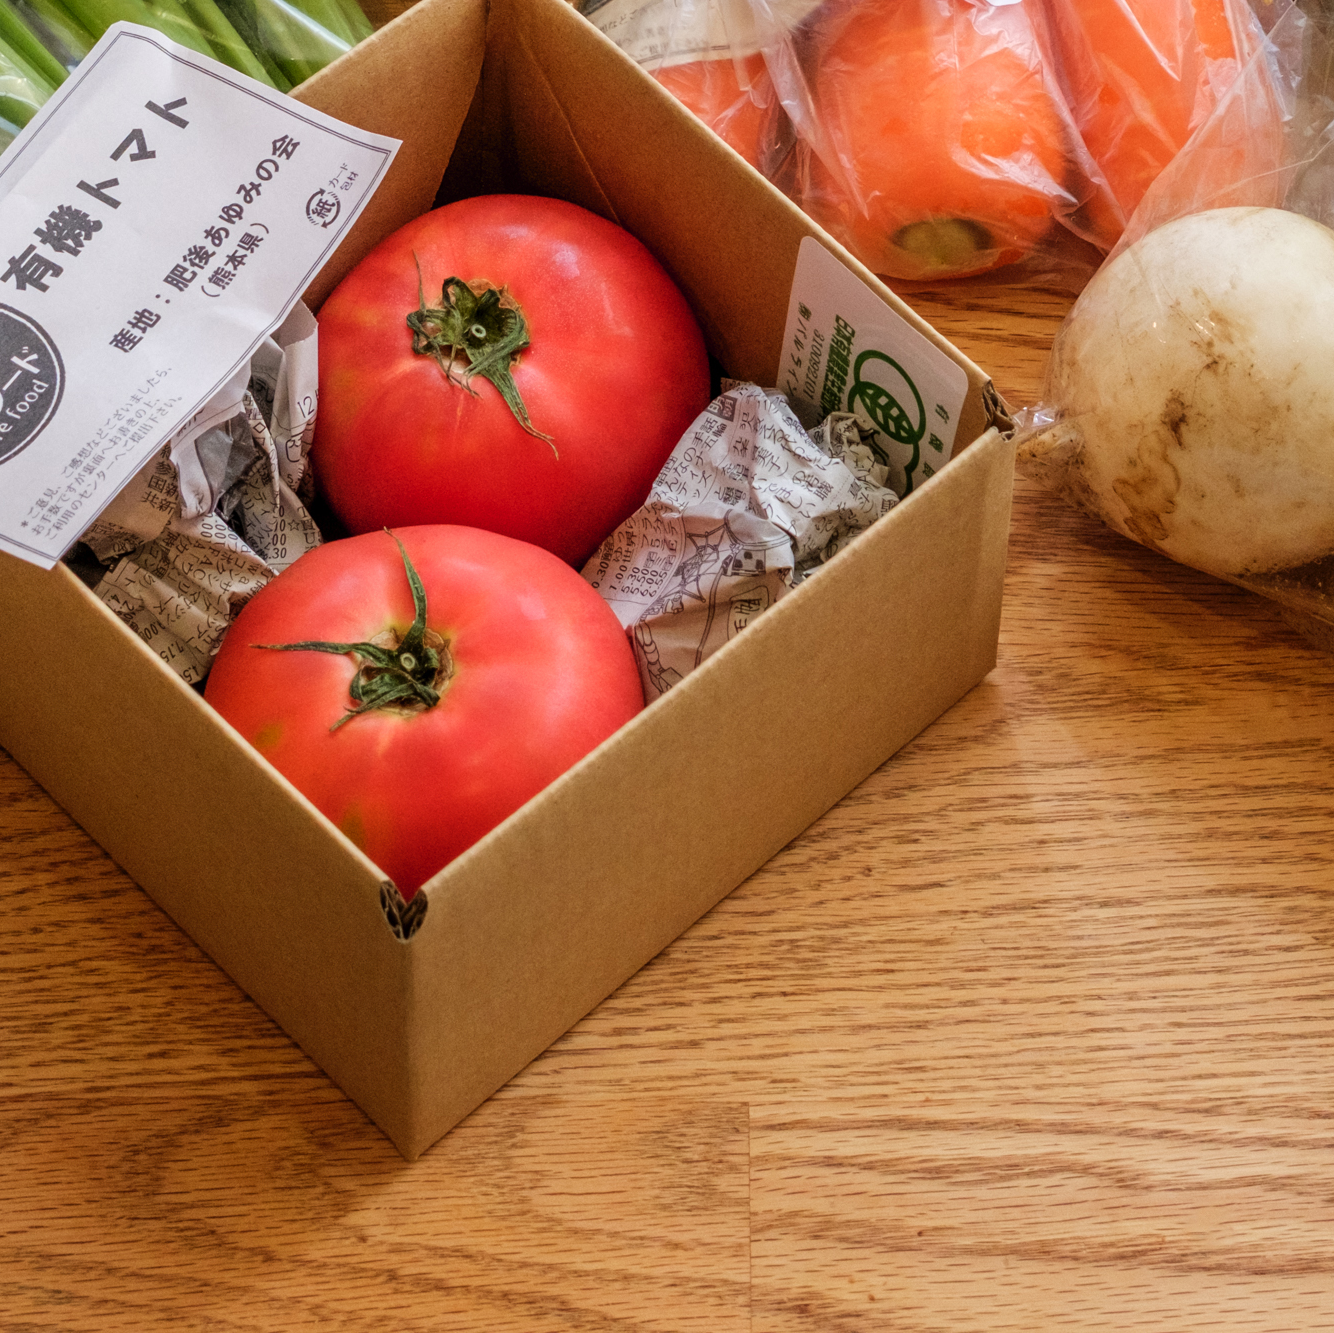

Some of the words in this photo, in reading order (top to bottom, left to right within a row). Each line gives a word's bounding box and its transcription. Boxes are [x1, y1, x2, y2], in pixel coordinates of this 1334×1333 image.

[0, 97, 189, 293] 有機トマト
[109, 135, 300, 353] 産地：肥後あゆみの会
[310, 195, 336, 221] 紙
[6, 375, 49, 422] food
